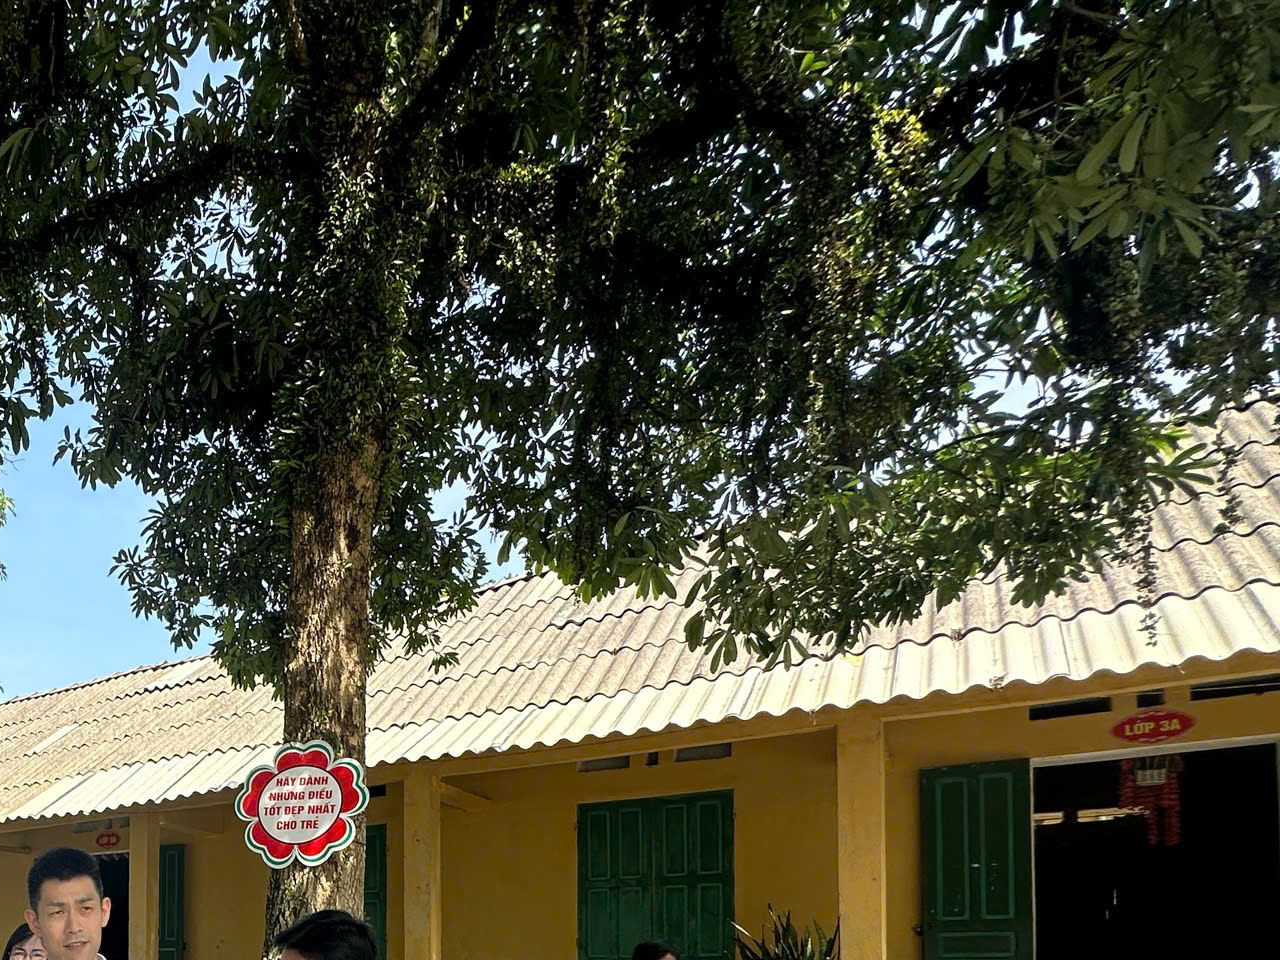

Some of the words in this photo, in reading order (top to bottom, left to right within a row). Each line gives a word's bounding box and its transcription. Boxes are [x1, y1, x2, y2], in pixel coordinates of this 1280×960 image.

[1160, 719, 1180, 731] 3A
[299, 775, 328, 786] DÀNH
[269, 790, 305, 801] NHỮNG
[264, 803, 281, 816] TỐT
[284, 806, 304, 817] ĐẸP
[307, 801, 336, 814] NHẤT
[276, 820, 297, 830] CHO
[300, 816, 319, 829] TRẺ
